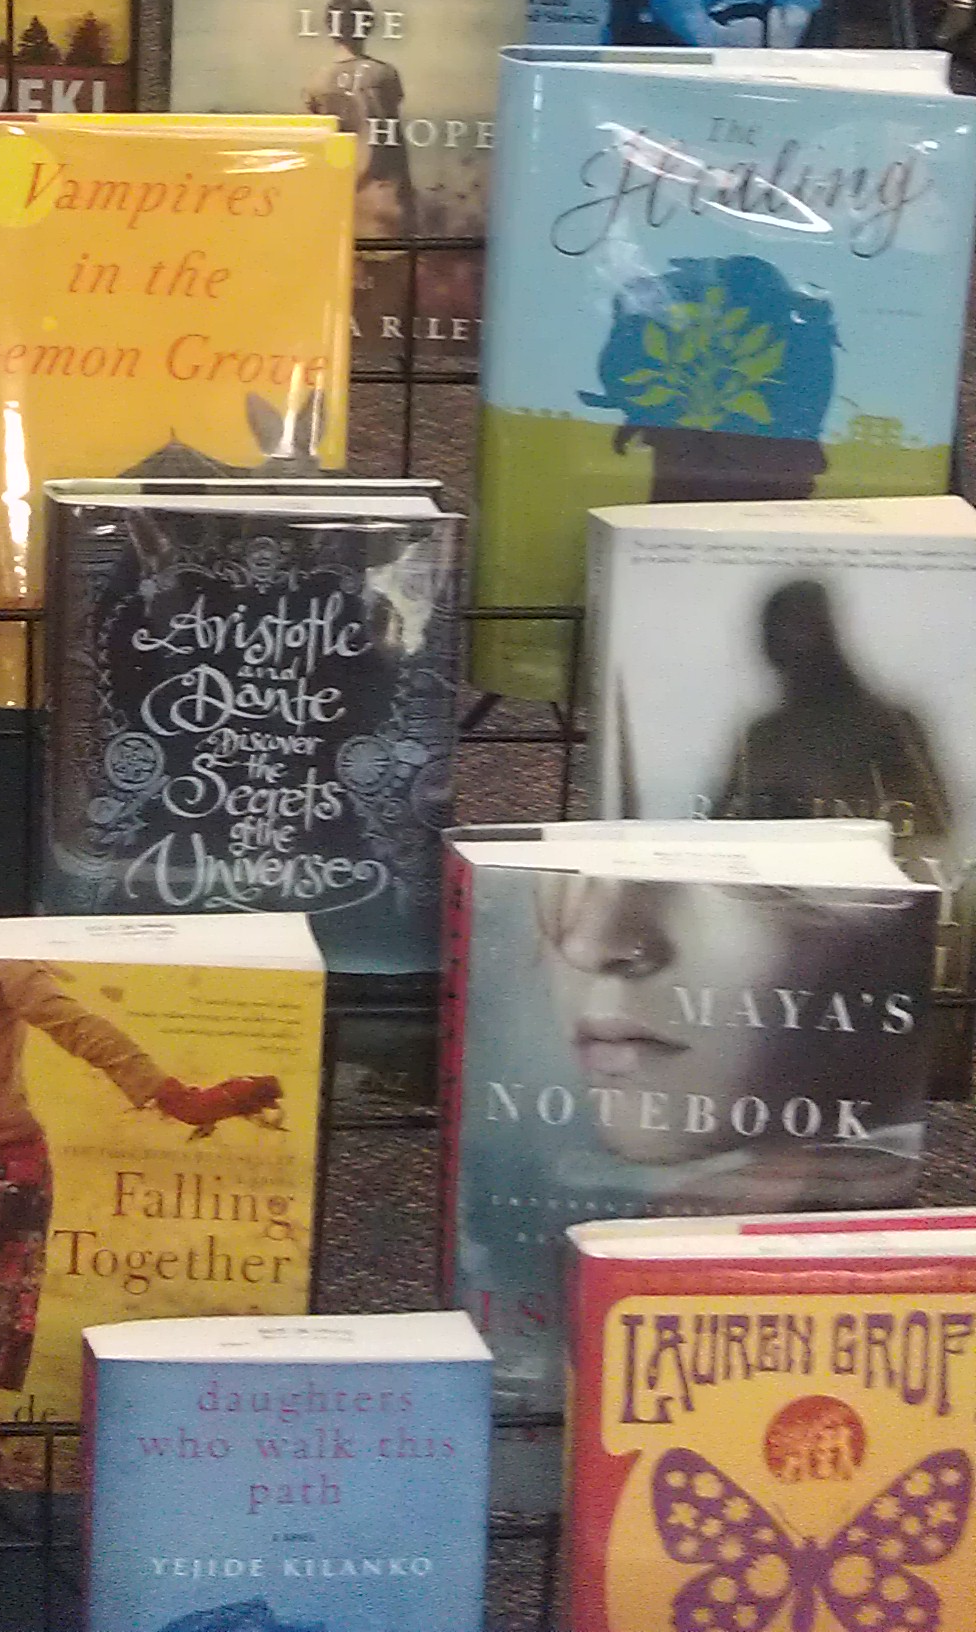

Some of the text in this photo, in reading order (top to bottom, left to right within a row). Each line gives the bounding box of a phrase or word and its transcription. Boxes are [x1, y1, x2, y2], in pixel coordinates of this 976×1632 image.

[298, 9, 406, 39] LIFE
[24, 162, 283, 230] Vampires
[67, 250, 232, 300] in the
[166, 333, 330, 387] Grove
[131, 591, 374, 671] Aristotle
[237, 662, 297, 681] and
[140, 664, 347, 736] Dante
[237, 752, 289, 784] the
[125, 831, 387, 913] Universe
[669, 986, 917, 1036] MAYA'S
[487, 1082, 874, 1141] NOTEBOOK
[112, 1171, 295, 1243] Falling
[53, 1229, 292, 1296] Together
[621, 1313, 814, 1423] LAUREN
[197, 1380, 414, 1423] daughters
[137, 1427, 456, 1459] who walk this
[248, 1474, 342, 1515] path
[152, 1556, 432, 1577] YEJIDE KILANKO
